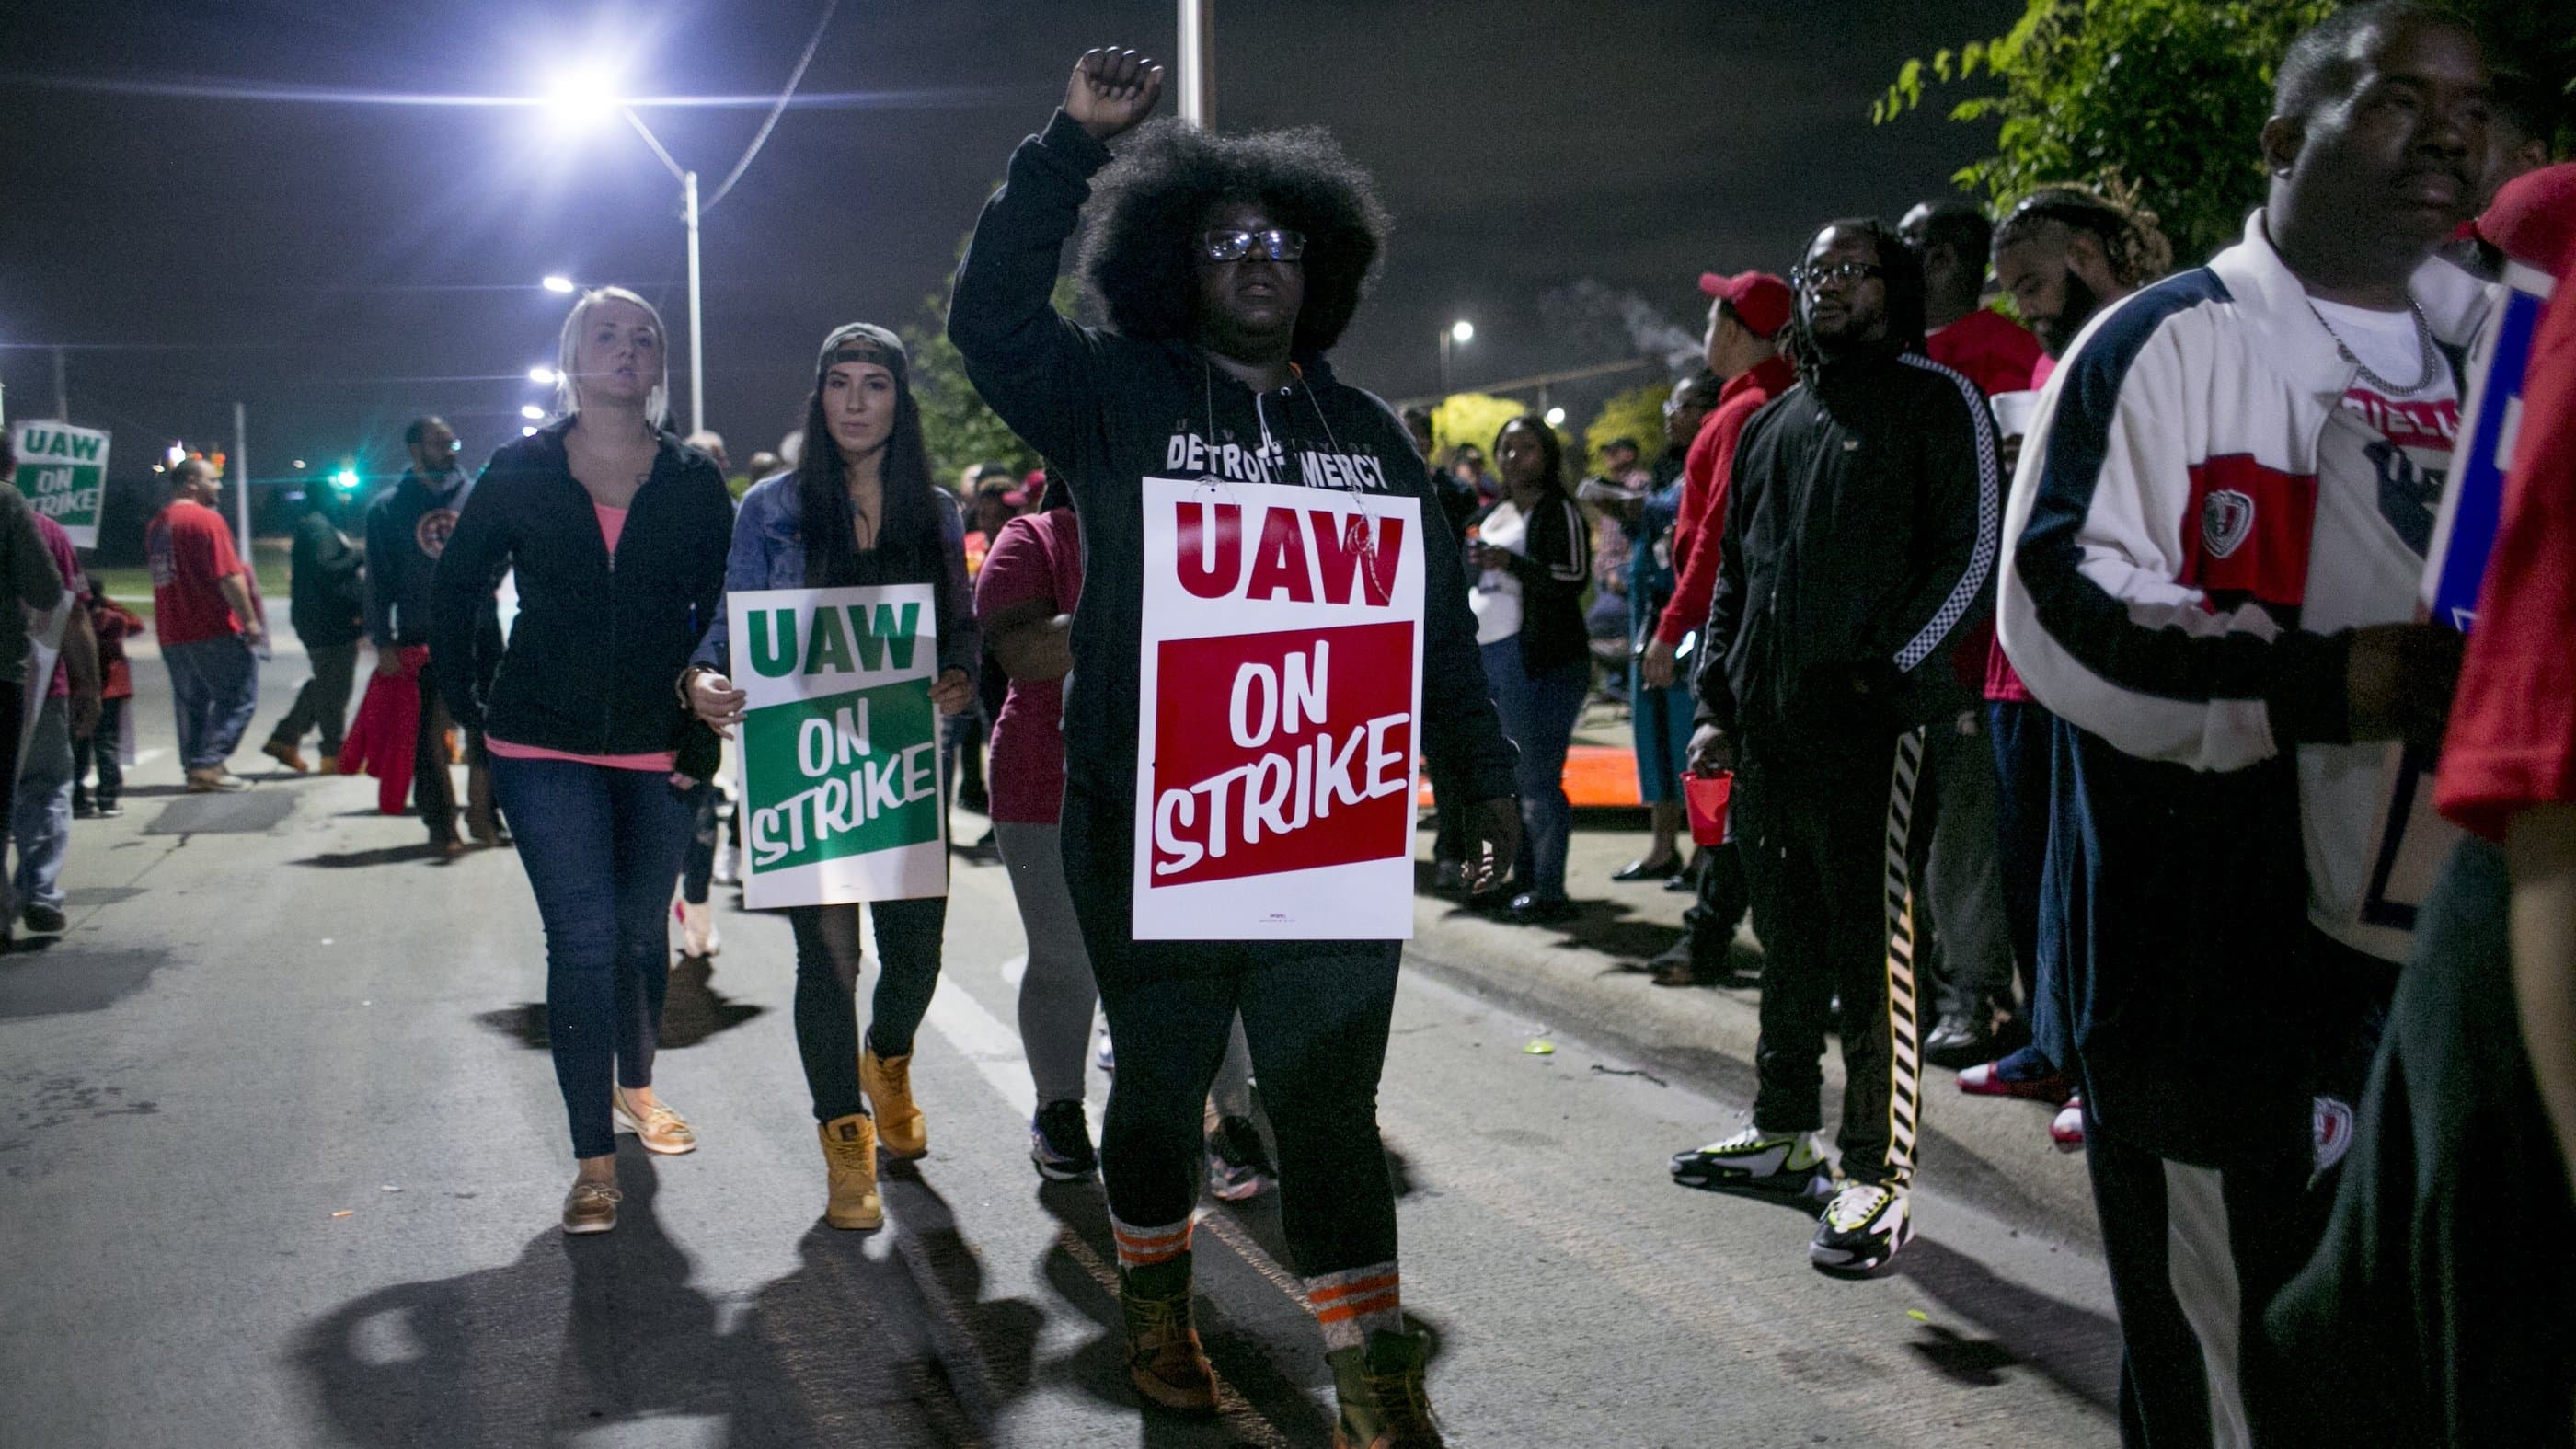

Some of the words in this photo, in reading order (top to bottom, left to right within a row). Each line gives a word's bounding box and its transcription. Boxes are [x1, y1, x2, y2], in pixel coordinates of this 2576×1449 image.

[25, 428, 101, 460] UAW
[37, 466, 74, 494] ON
[1295, 451, 1388, 489] MERCY
[1176, 501, 1404, 607] UAW
[747, 603, 921, 679] UAW
[1229, 640, 1329, 748] ON
[798, 697, 871, 777] ON
[751, 742, 937, 867] STRIKE
[1155, 712, 1410, 876] STRIKE
